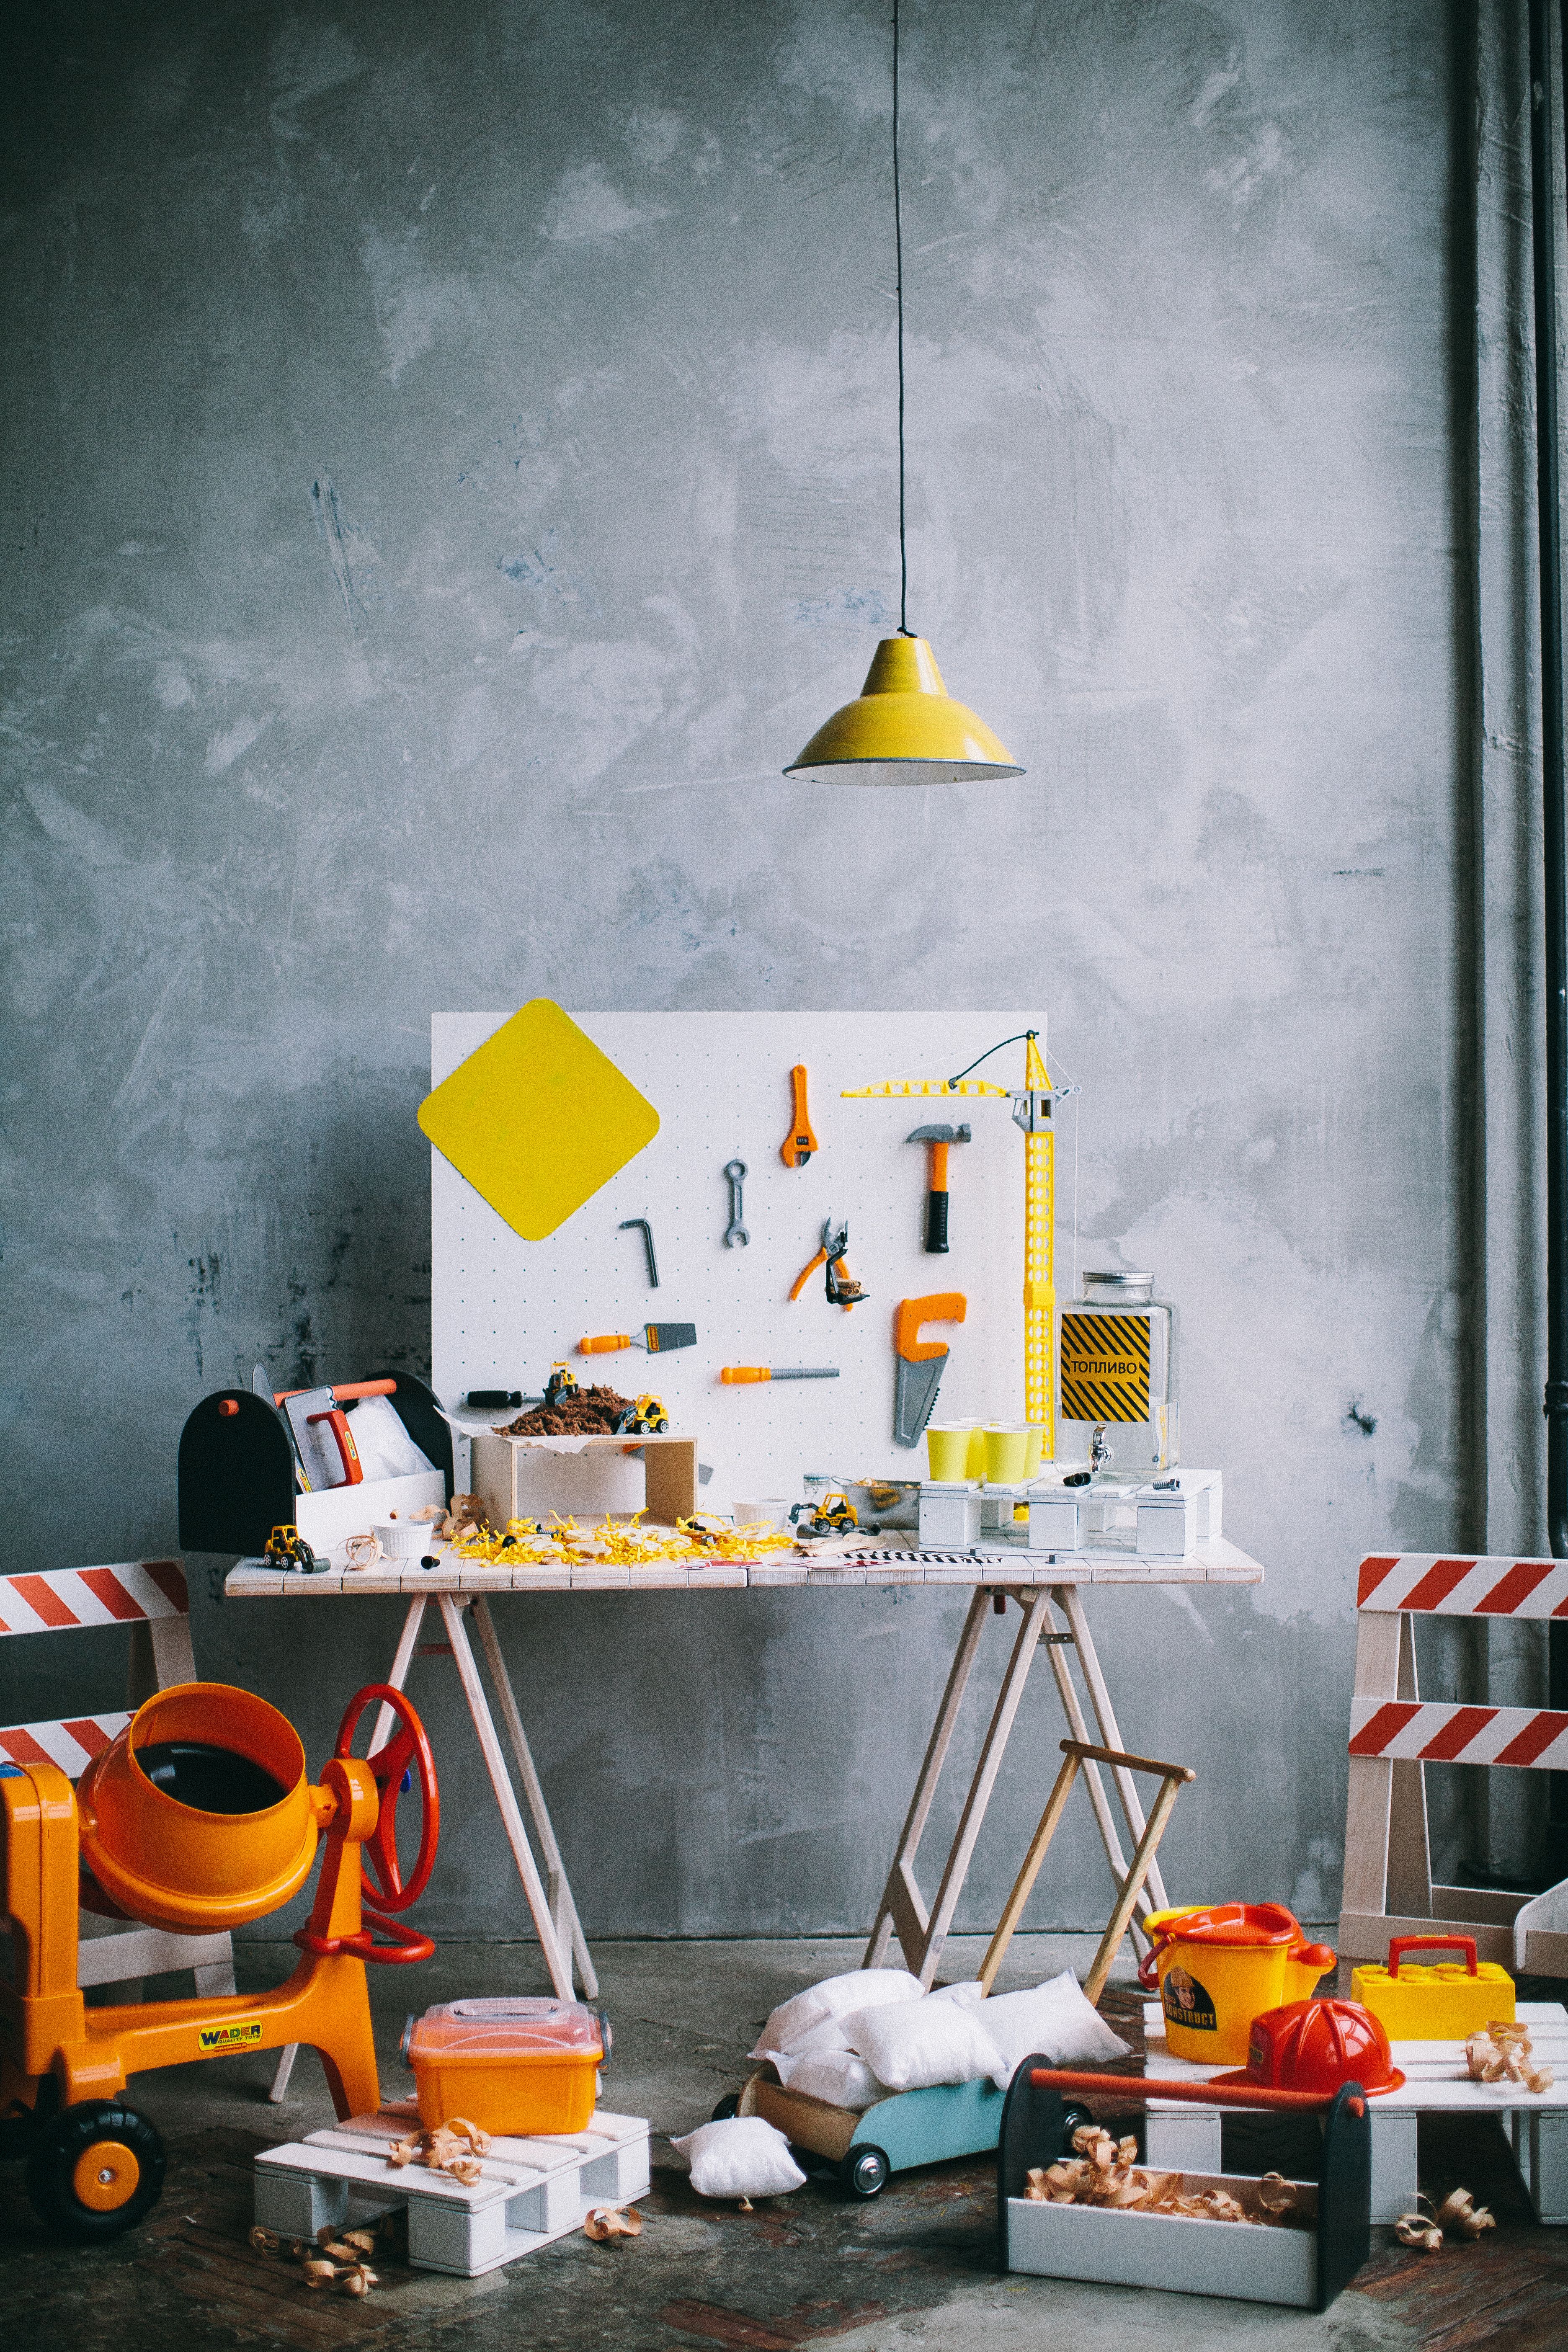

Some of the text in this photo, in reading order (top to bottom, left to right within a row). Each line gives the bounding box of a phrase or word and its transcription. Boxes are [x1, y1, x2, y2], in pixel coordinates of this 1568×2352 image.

[1071, 1360, 1137, 1374] ТОПЛИВО
[1166, 2002, 1213, 2024] CONSTRUCT
[201, 2024, 261, 2045] WADER
